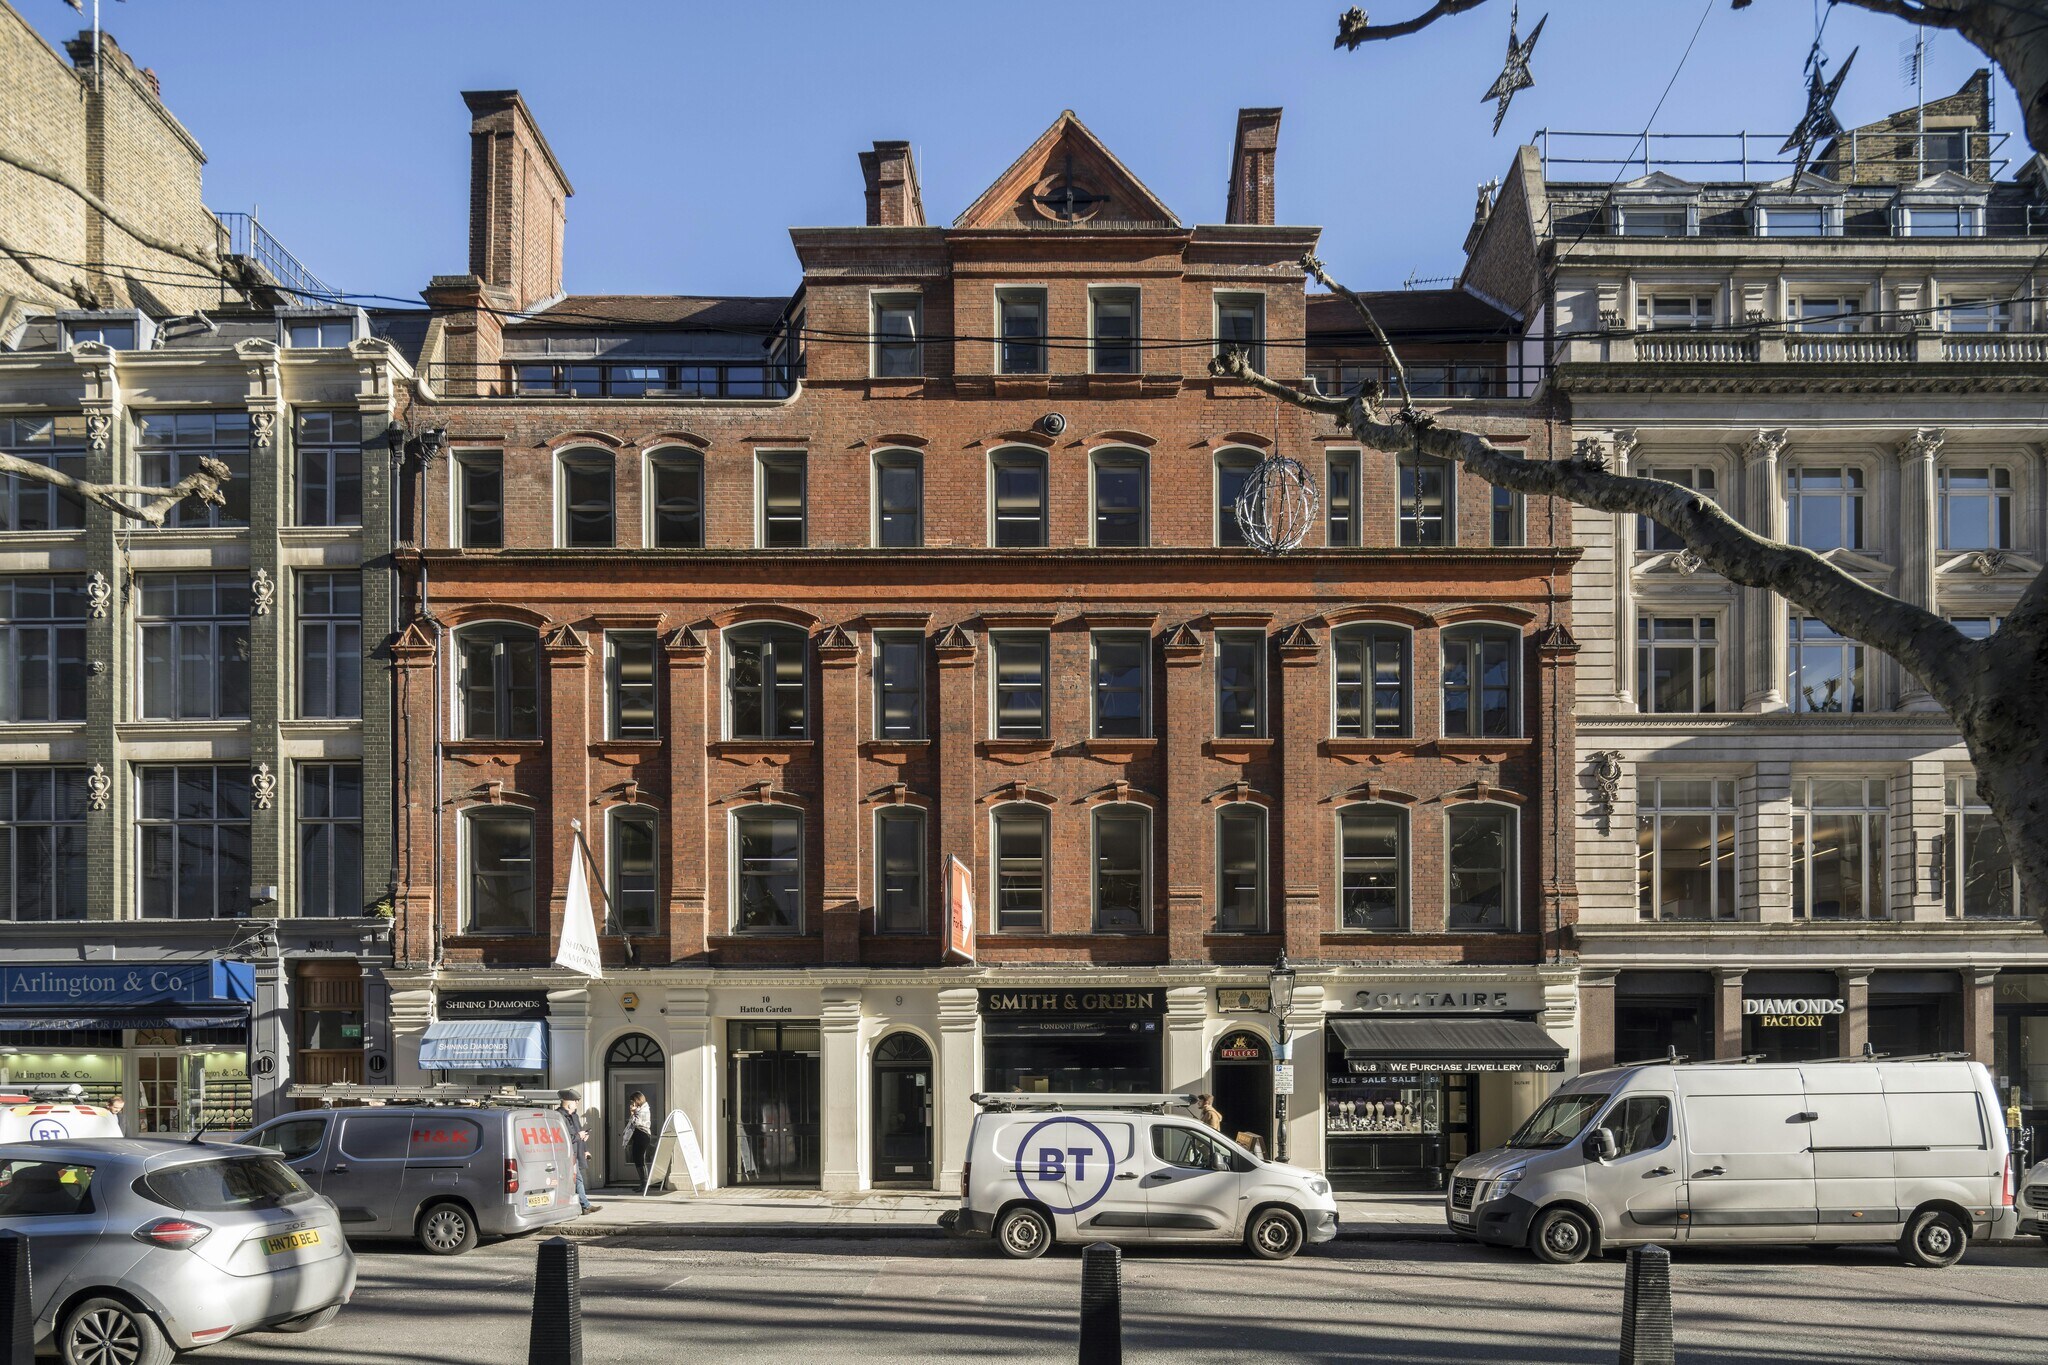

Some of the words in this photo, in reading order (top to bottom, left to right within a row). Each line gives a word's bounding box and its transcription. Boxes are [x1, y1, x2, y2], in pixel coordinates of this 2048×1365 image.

[11, 971, 116, 997] Arlington
[123, 971, 144, 992] &
[151, 971, 188, 992] Co.
[445, 1000, 486, 1009] SHINING
[489, 1000, 540, 1009] DIAMONDS
[895, 995, 903, 1006] 9
[990, 994, 1058, 1010] SMITH
[1064, 994, 1079, 1010] &
[1082, 993, 1154, 1010] GREEN
[1355, 990, 1508, 1007] SOLITAIRE
[1744, 999, 1845, 1014] DIAMONDS
[1762, 1015, 1824, 1027] FACTORY
[438, 1043, 469, 1051] SHINING
[470, 1042, 509, 1050] DIAMONDS
[1355, 1064, 1376, 1072] No.8
[1390, 1063, 1407, 1071] WE
[1409, 1063, 1462, 1071] PURCHASE
[1464, 1063, 1522, 1071] JEWELLERY
[74, 1071, 92, 1079] Co.
[1362, 1076, 1387, 1084] SALE
[412, 1129, 469, 1144] H&K
[521, 1127, 564, 1146] H&K
[1039, 1147, 1093, 1182] BT
[284, 1221, 306, 1231] ZOE
[268, 1236, 299, 1252] HN70
[299, 1232, 319, 1245] BEJ
